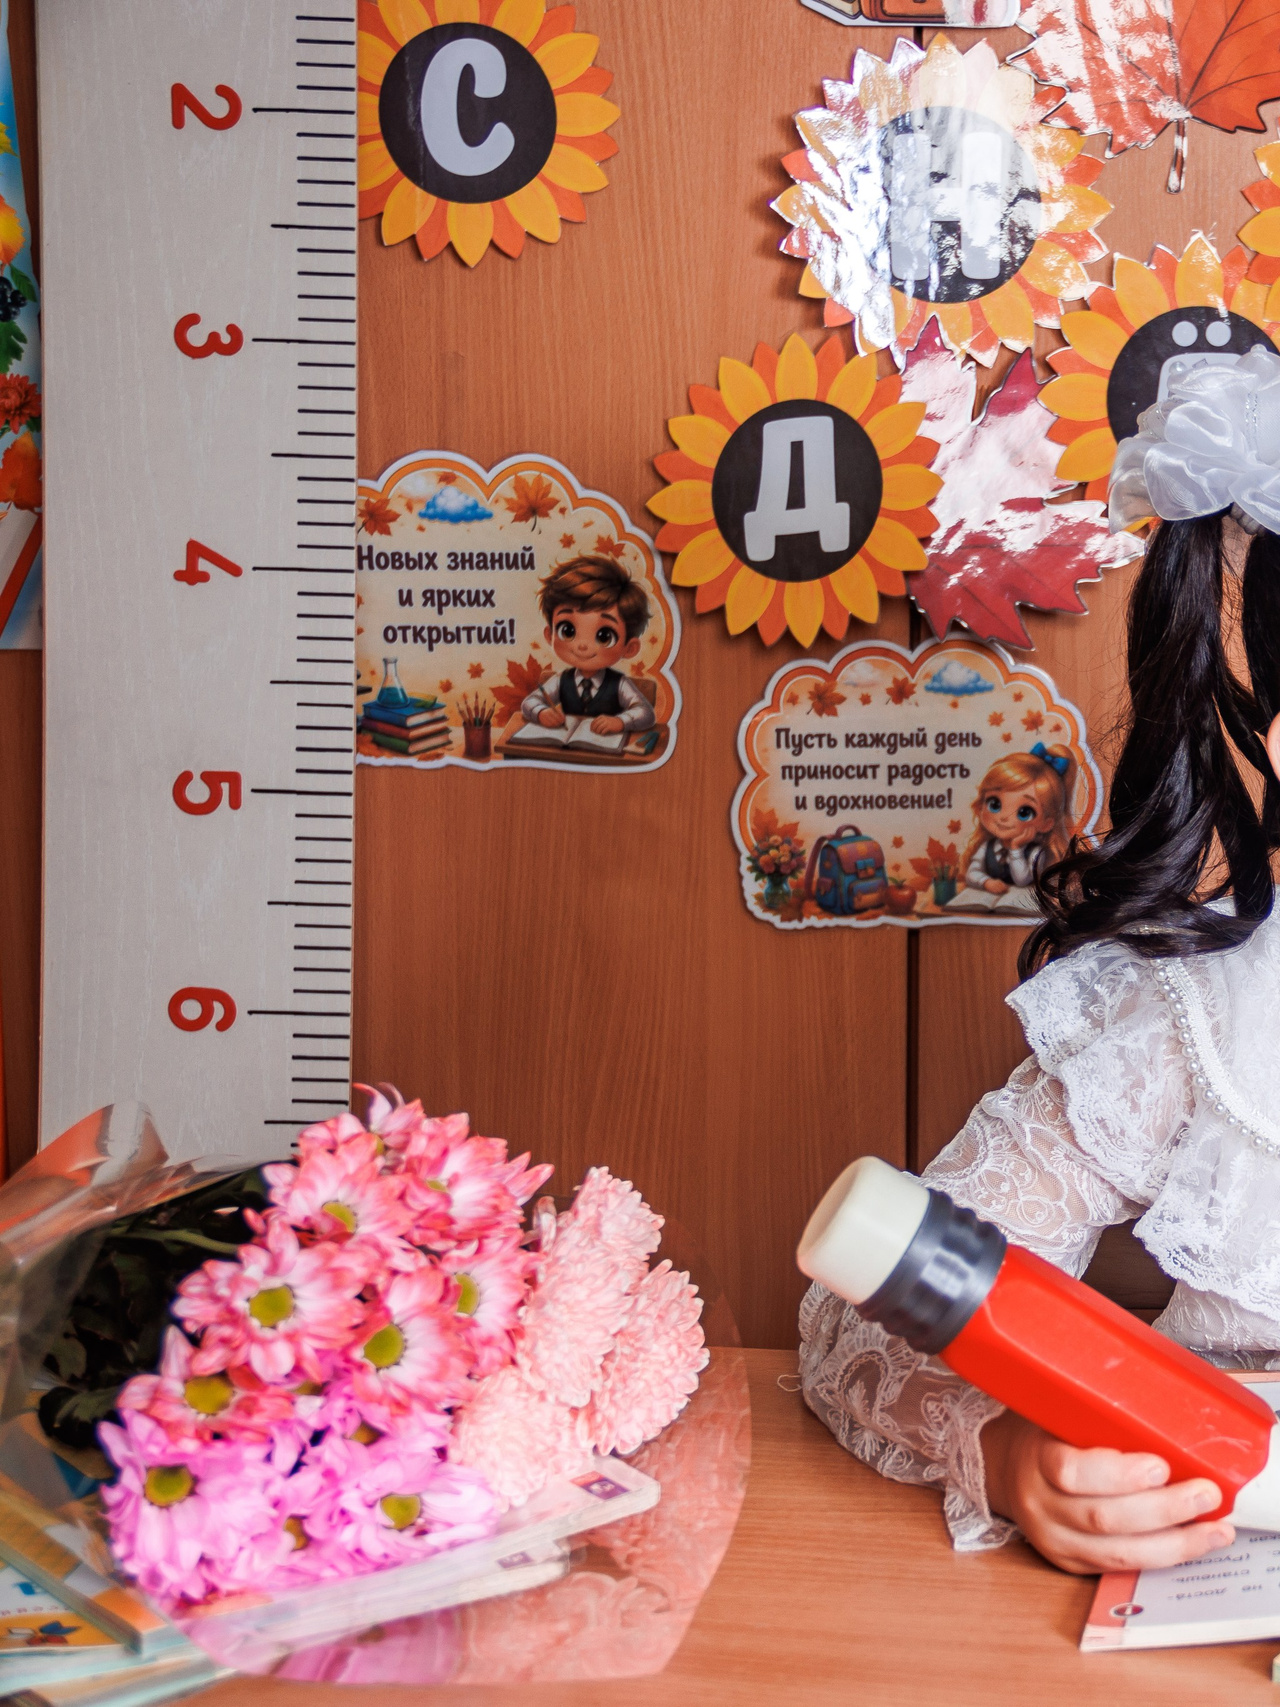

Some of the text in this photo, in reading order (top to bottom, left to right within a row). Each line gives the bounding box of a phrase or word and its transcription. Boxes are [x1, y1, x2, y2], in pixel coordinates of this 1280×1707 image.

[171, 83, 242, 131] 2
[420, 37, 515, 177] С
[174, 313, 243, 359] 3
[743, 415, 851, 563] Д
[173, 539, 243, 586] 4
[357, 545, 536, 571] Новых знаний
[398, 587, 496, 616] и ярких
[383, 619, 516, 652] открытий!
[775, 727, 982, 756] Пусть каждый день
[172, 769, 242, 816] 5
[781, 760, 971, 786] приносит радость
[795, 788, 954, 816] и вдохновение!
[168, 986, 238, 1032] 6
